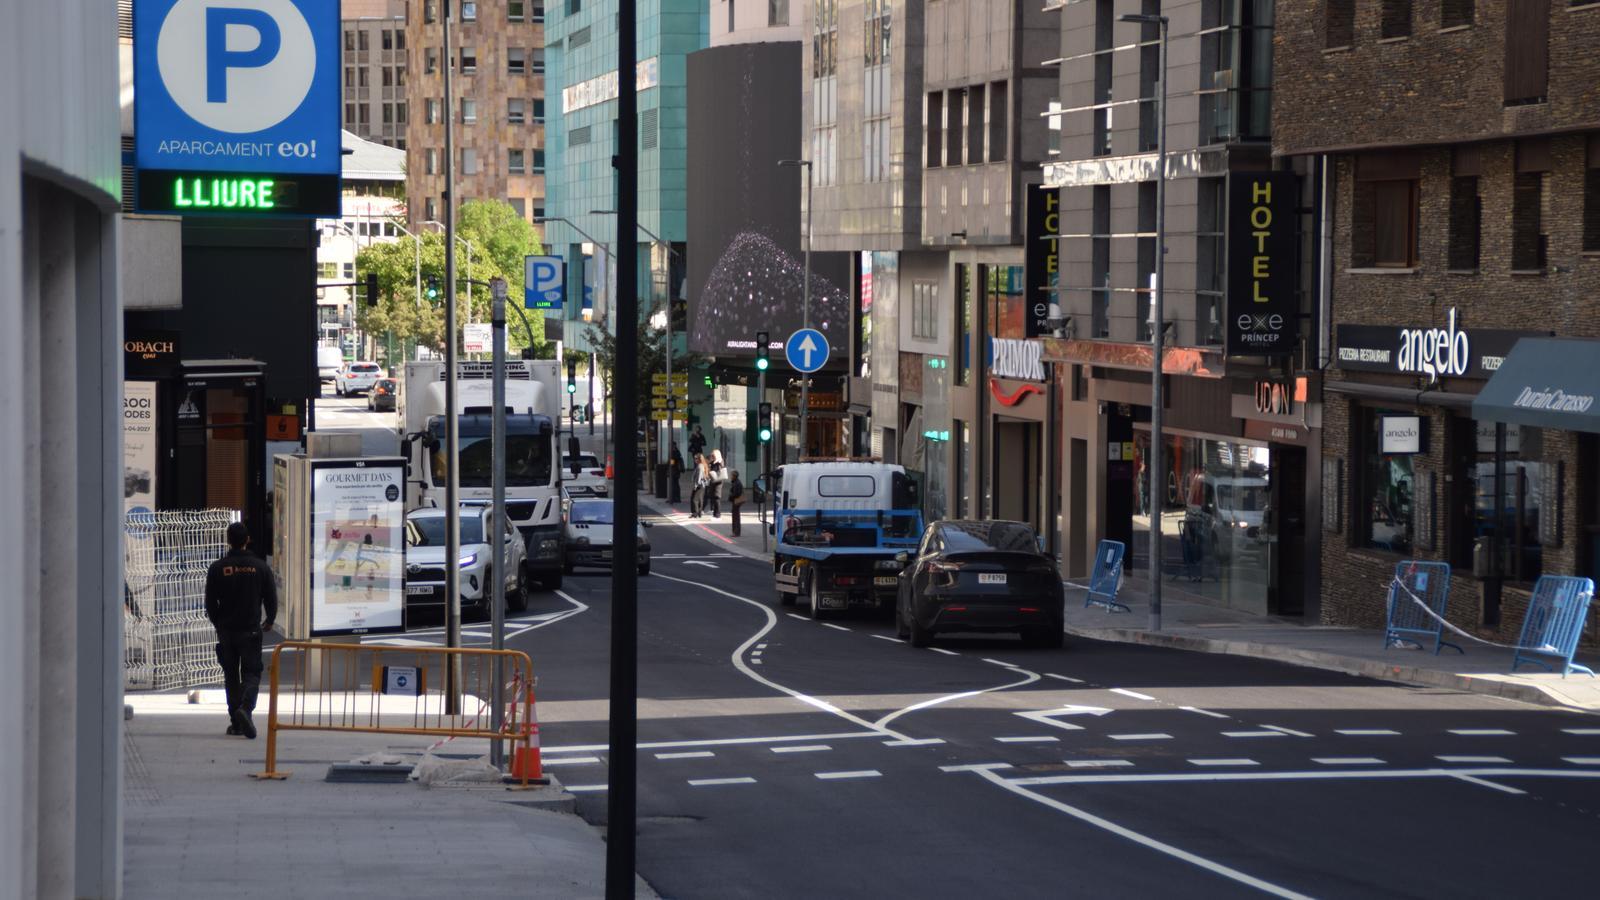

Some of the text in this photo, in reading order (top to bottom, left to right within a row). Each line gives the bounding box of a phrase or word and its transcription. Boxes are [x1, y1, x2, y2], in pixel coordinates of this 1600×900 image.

[206, 7, 281, 104] P
[158, 140, 317, 158] APARCAMENT eo!
[174, 177, 275, 208] LLIURE
[1250, 181, 1273, 303] HOTEL
[533, 262, 556, 291] P
[1241, 333, 1280, 343] PRÍNCEP
[1398, 307, 1469, 384] angelo
[992, 337, 1045, 380] PRIMOR
[1255, 381, 1291, 415] UDON
[1385, 428, 1418, 440] angelo
[325, 472, 392, 483] GOURMET DAYS
